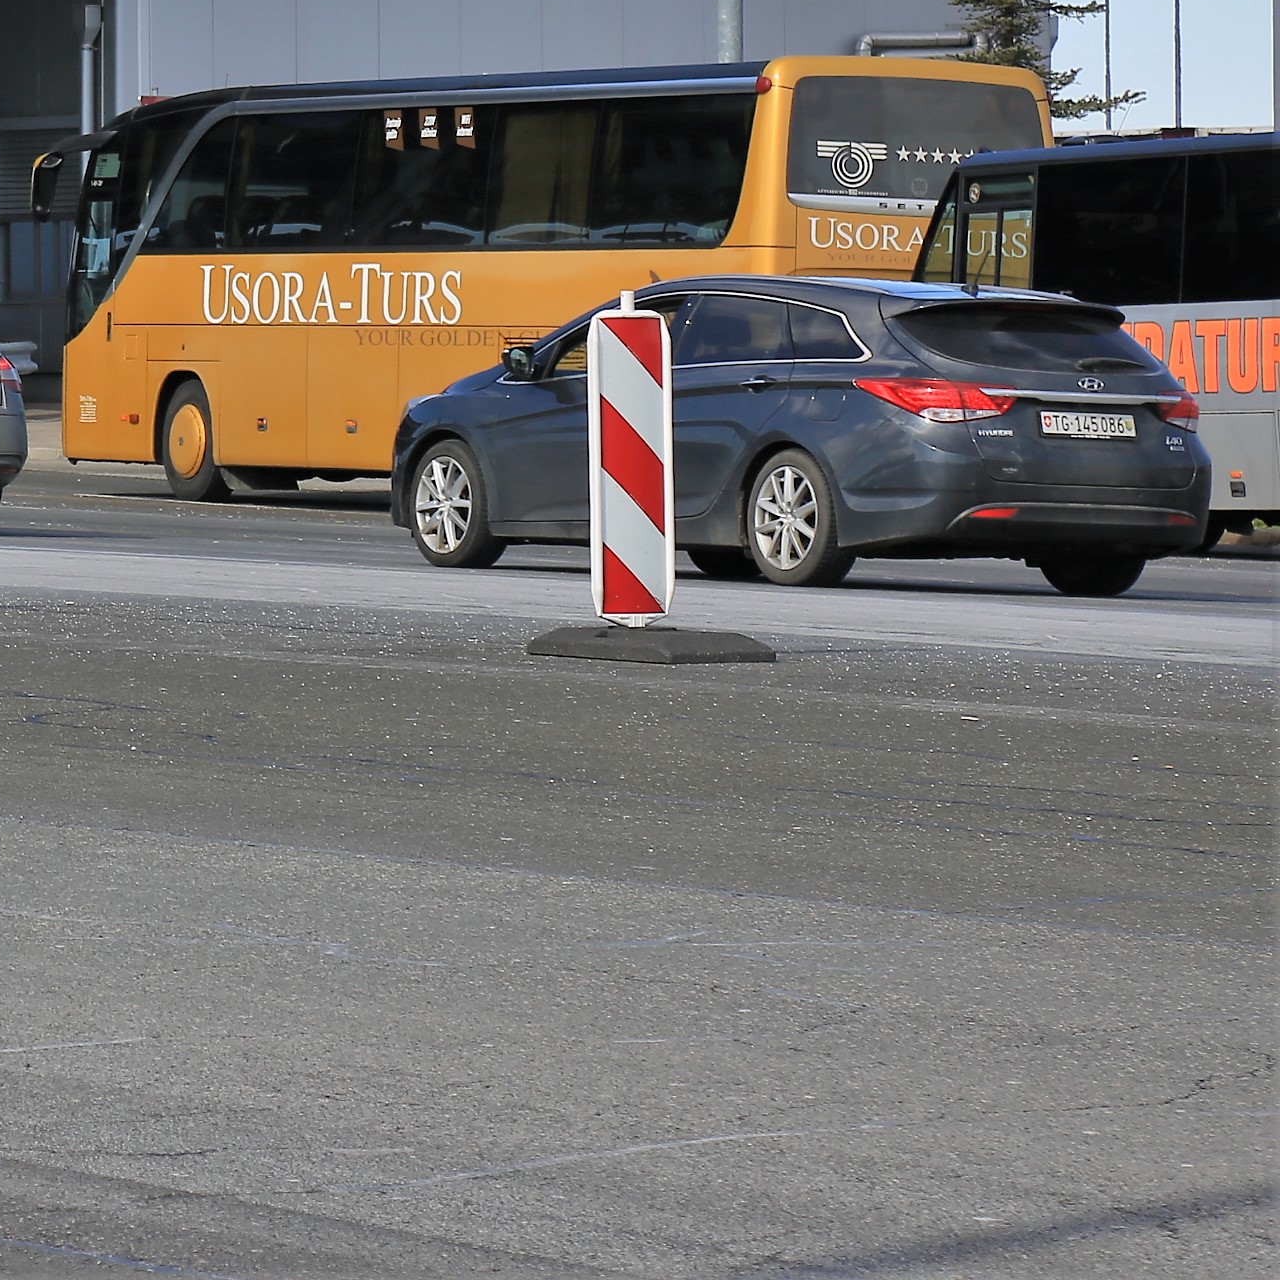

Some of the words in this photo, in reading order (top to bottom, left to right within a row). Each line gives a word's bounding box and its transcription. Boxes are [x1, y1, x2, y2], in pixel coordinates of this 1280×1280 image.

[200, 263, 462, 325] USORA-TURS
[355, 329, 413, 346] YOUR
[420, 329, 511, 347] GOLDEN
